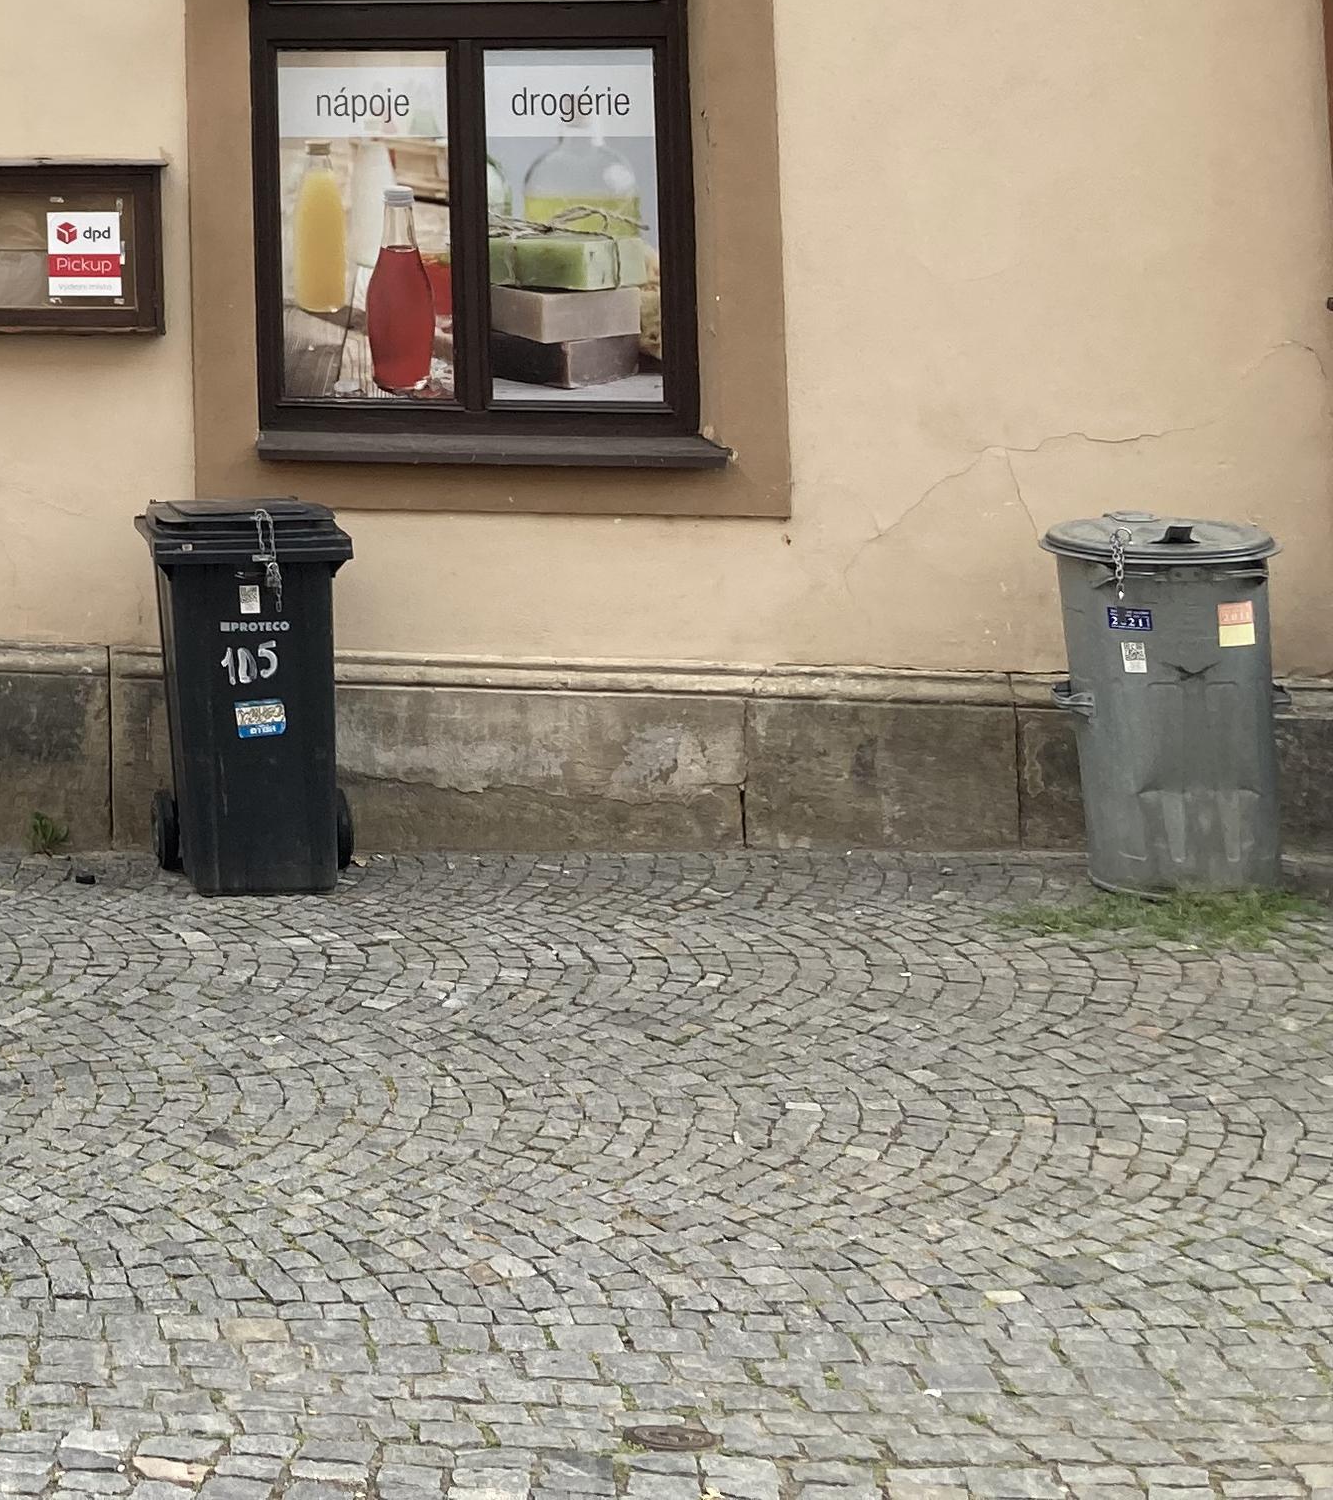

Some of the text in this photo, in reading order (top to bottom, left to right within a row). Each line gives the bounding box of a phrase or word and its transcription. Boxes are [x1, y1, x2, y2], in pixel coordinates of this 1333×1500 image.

[315, 87, 411, 125] nápoje
[510, 85, 631, 123] drogérie
[82, 226, 111, 242] dpd
[56, 257, 113, 274] Pickup
[230, 621, 290, 632] PROTECO
[1110, 615, 1144, 628] 221
[220, 640, 279, 686] 105
